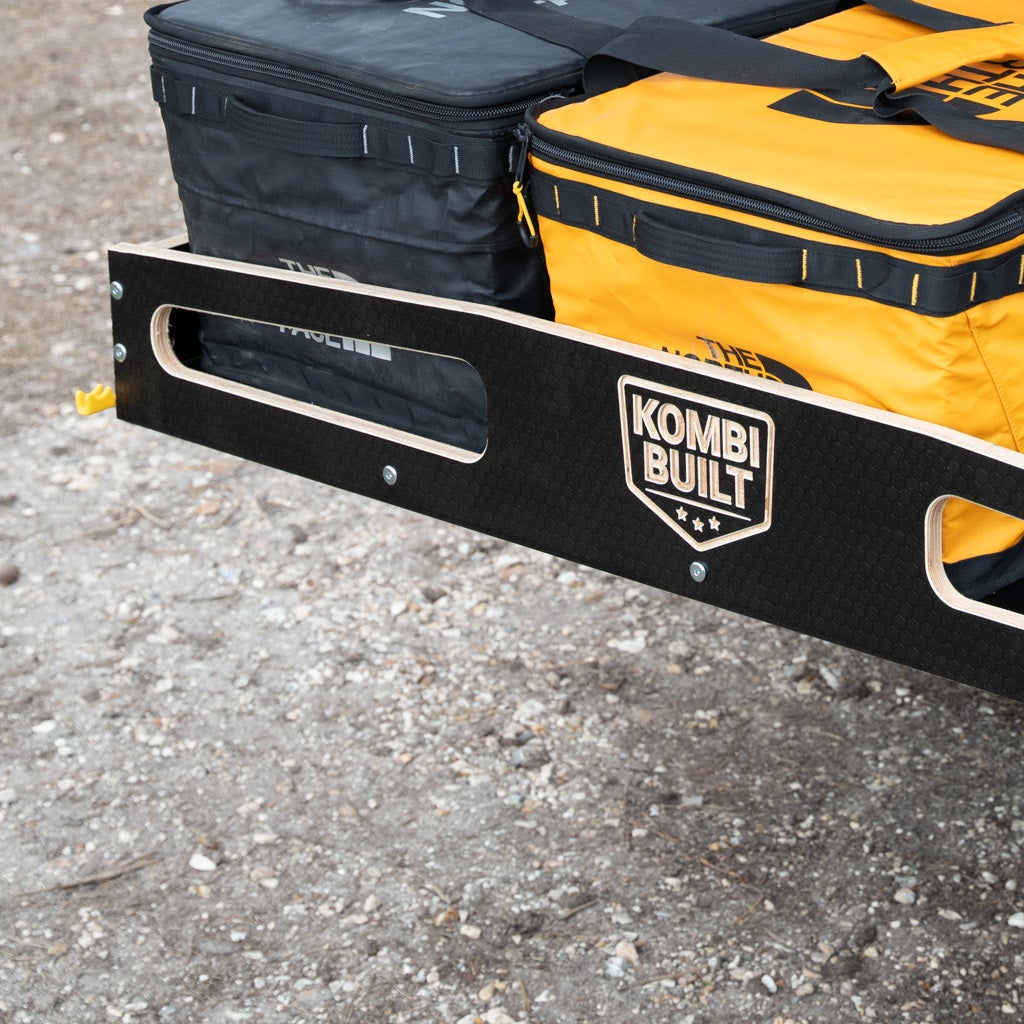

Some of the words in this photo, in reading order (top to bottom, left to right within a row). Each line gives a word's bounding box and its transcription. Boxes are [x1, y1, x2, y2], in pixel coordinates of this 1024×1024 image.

[695, 335, 763, 372] THE
[632, 393, 760, 469] KOMBI
[643, 440, 754, 509] BUILT
